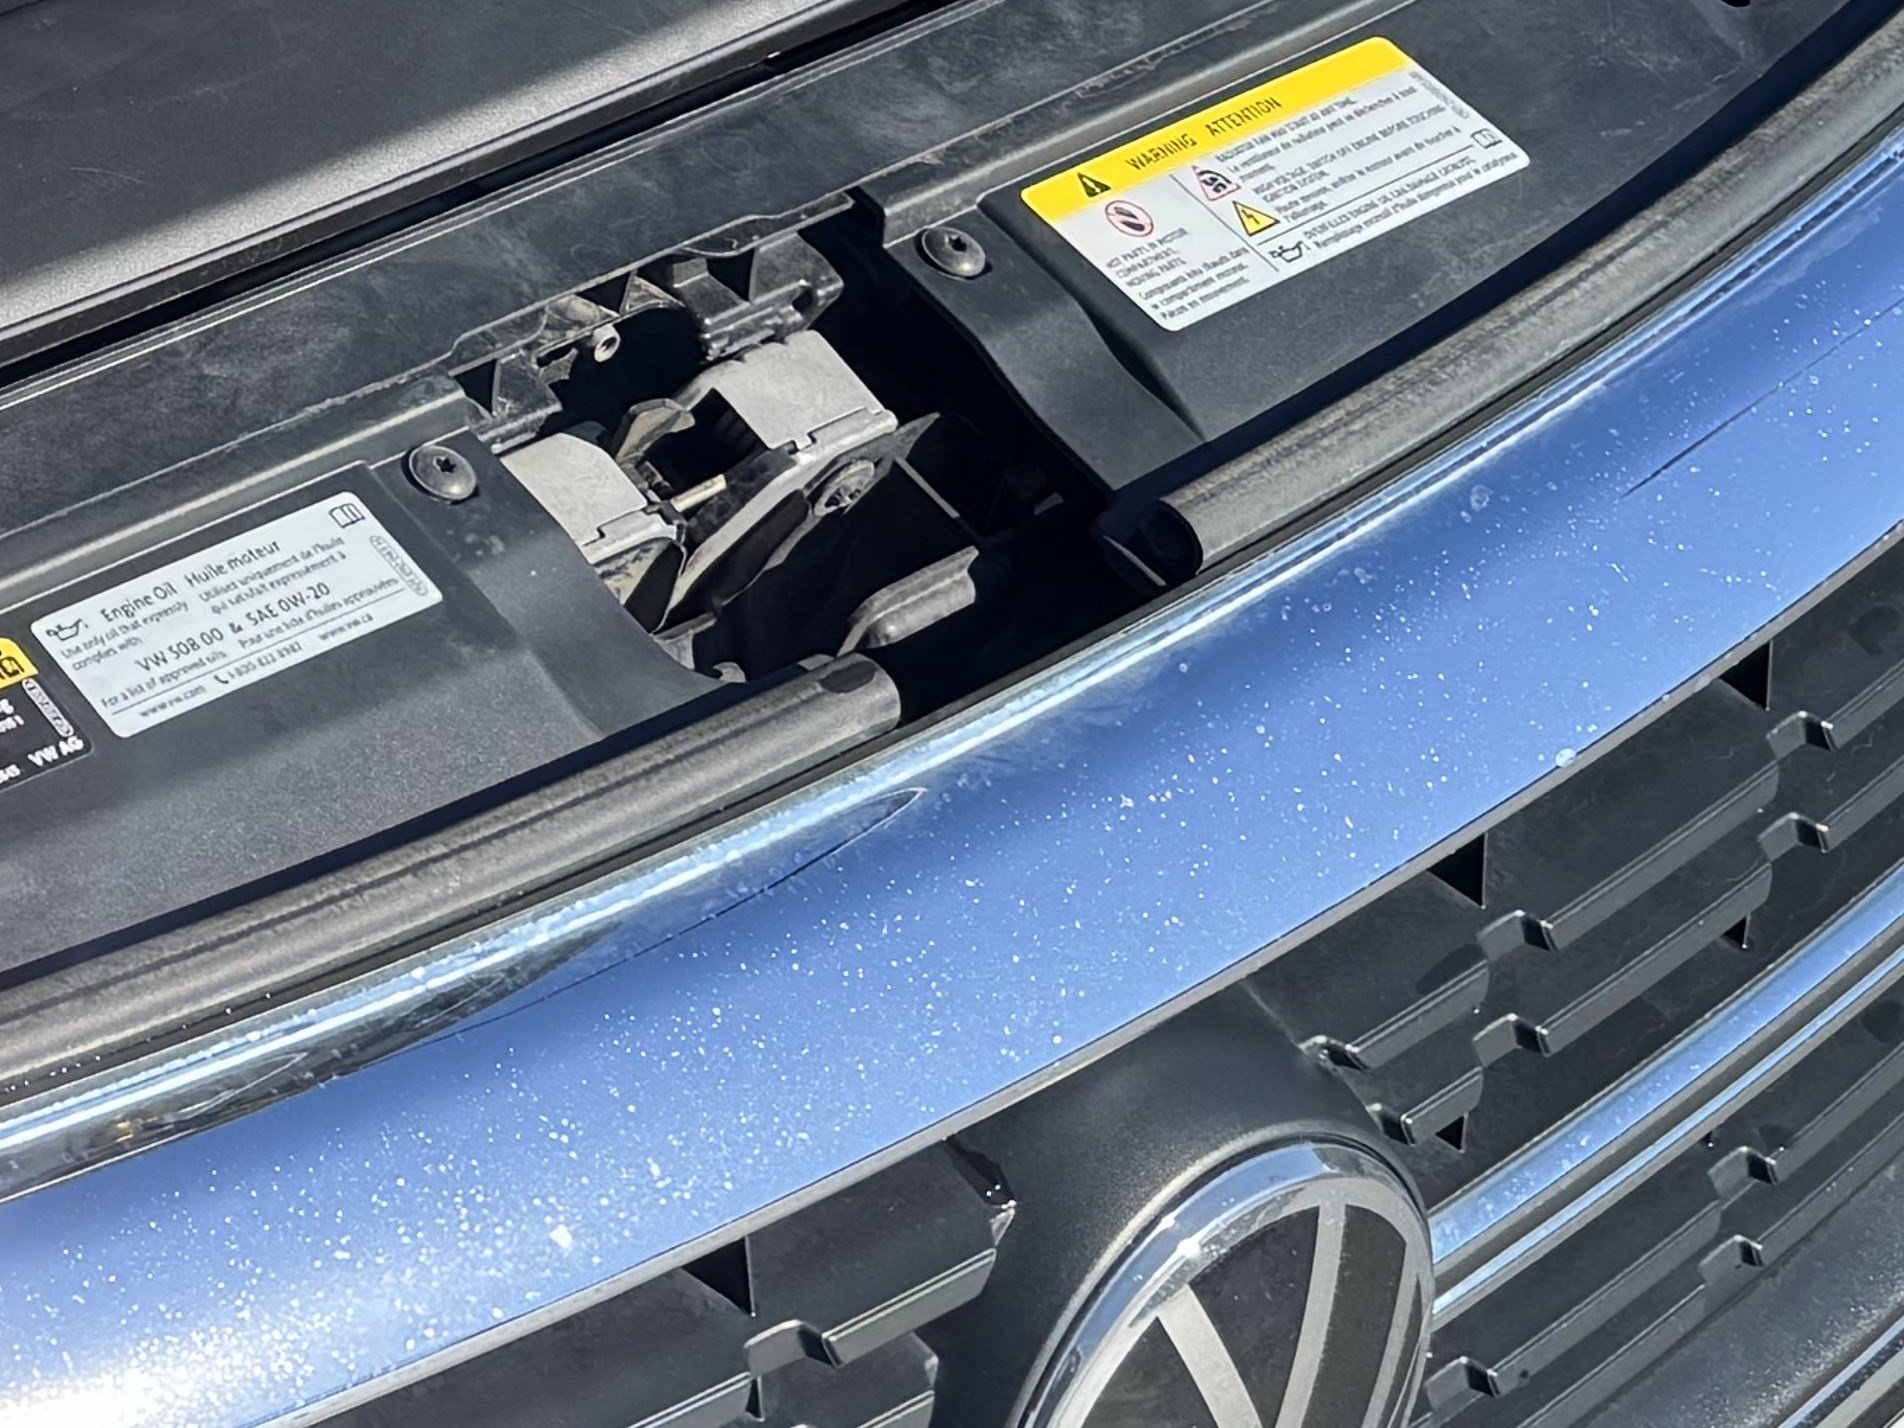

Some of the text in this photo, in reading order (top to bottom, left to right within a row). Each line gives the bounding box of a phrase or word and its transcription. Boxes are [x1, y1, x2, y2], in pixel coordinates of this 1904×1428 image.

[1125, 96, 1282, 170] WARNING ATTENTION
[183, 539, 281, 585] Huile moteur
[100, 582, 177, 624] Engine Oil
[136, 582, 331, 671] VW 508 00 & SAE 0W-20
[28, 735, 84, 766] VW AG
